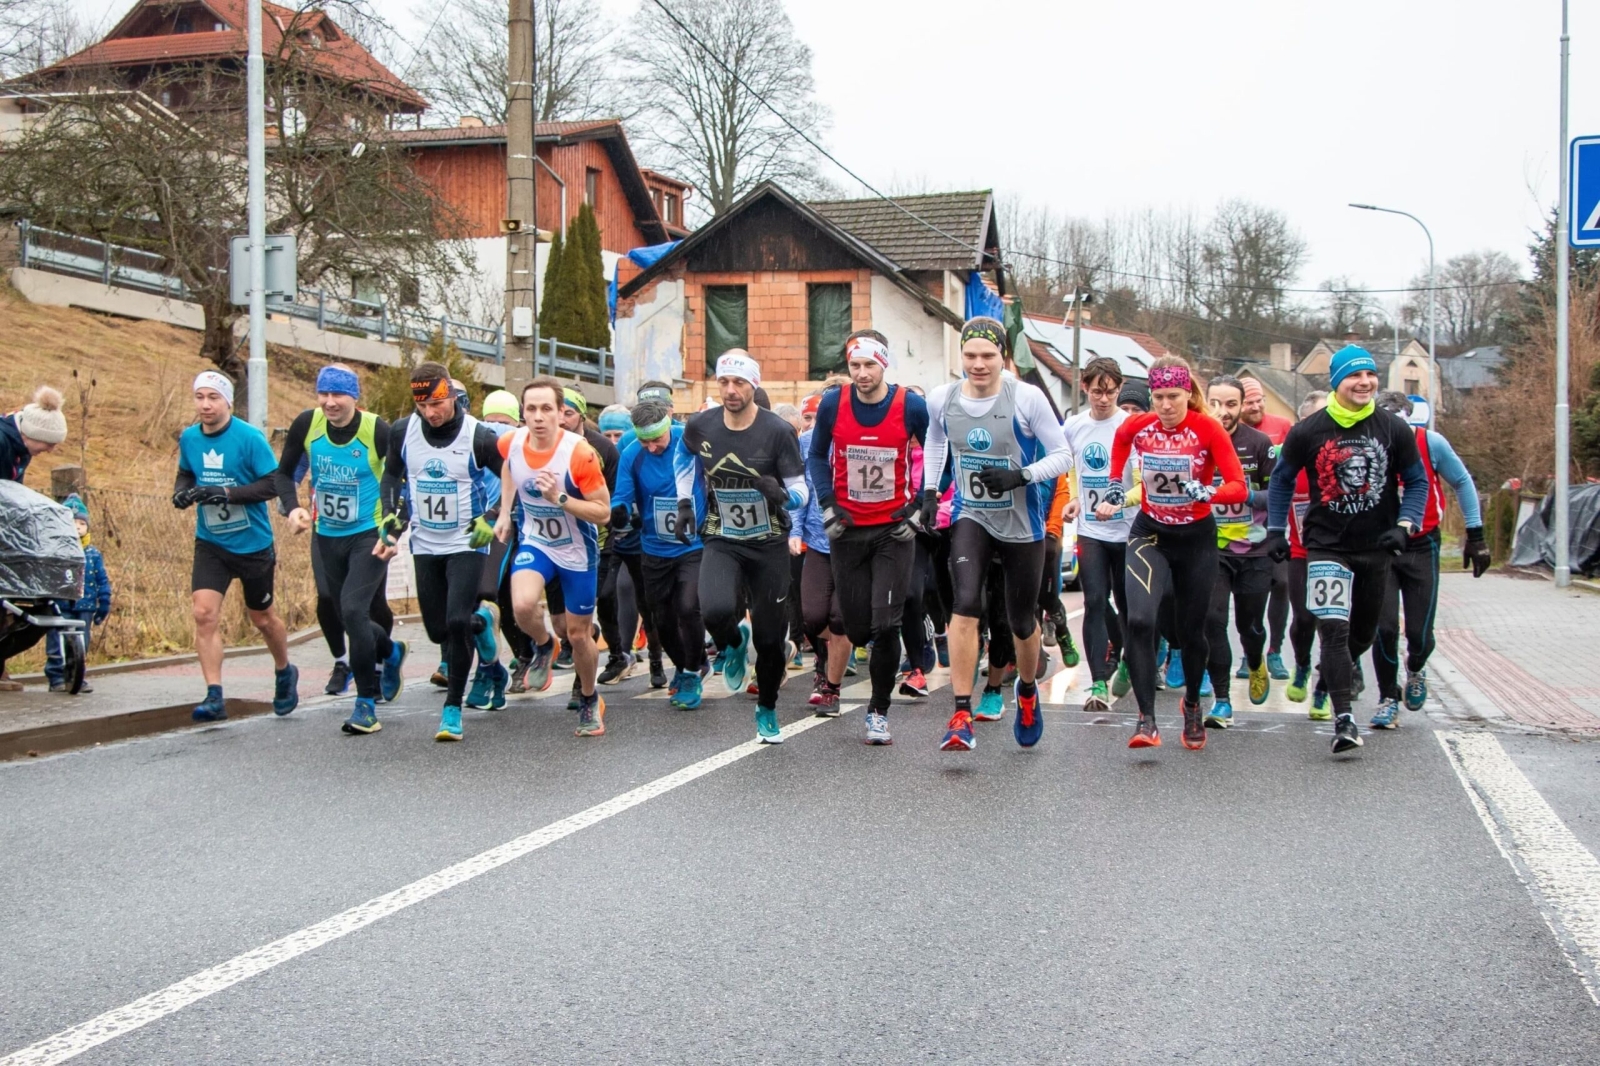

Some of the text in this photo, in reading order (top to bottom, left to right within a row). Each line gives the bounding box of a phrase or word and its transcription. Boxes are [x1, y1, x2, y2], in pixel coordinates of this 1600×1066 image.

[317, 455, 333, 463] THE
[847, 447, 868, 455] ZIMNÍ
[847, 453, 876, 461] BĚŽECKÁ
[961, 457, 994, 465] NOVOROČNÍ
[316, 463, 358, 477] WIKOV
[857, 464, 884, 489] 12
[1153, 472, 1184, 495] 21
[1342, 493, 1364, 501] AVE
[218, 502, 230, 522] 3
[323, 493, 350, 521] 55
[423, 495, 449, 521] 14
[1328, 500, 1374, 514] SLAVIA
[729, 504, 758, 529] 31
[533, 518, 562, 539] 20
[744, 525, 768, 534] KOSTELEC
[1314, 579, 1345, 606] 32
